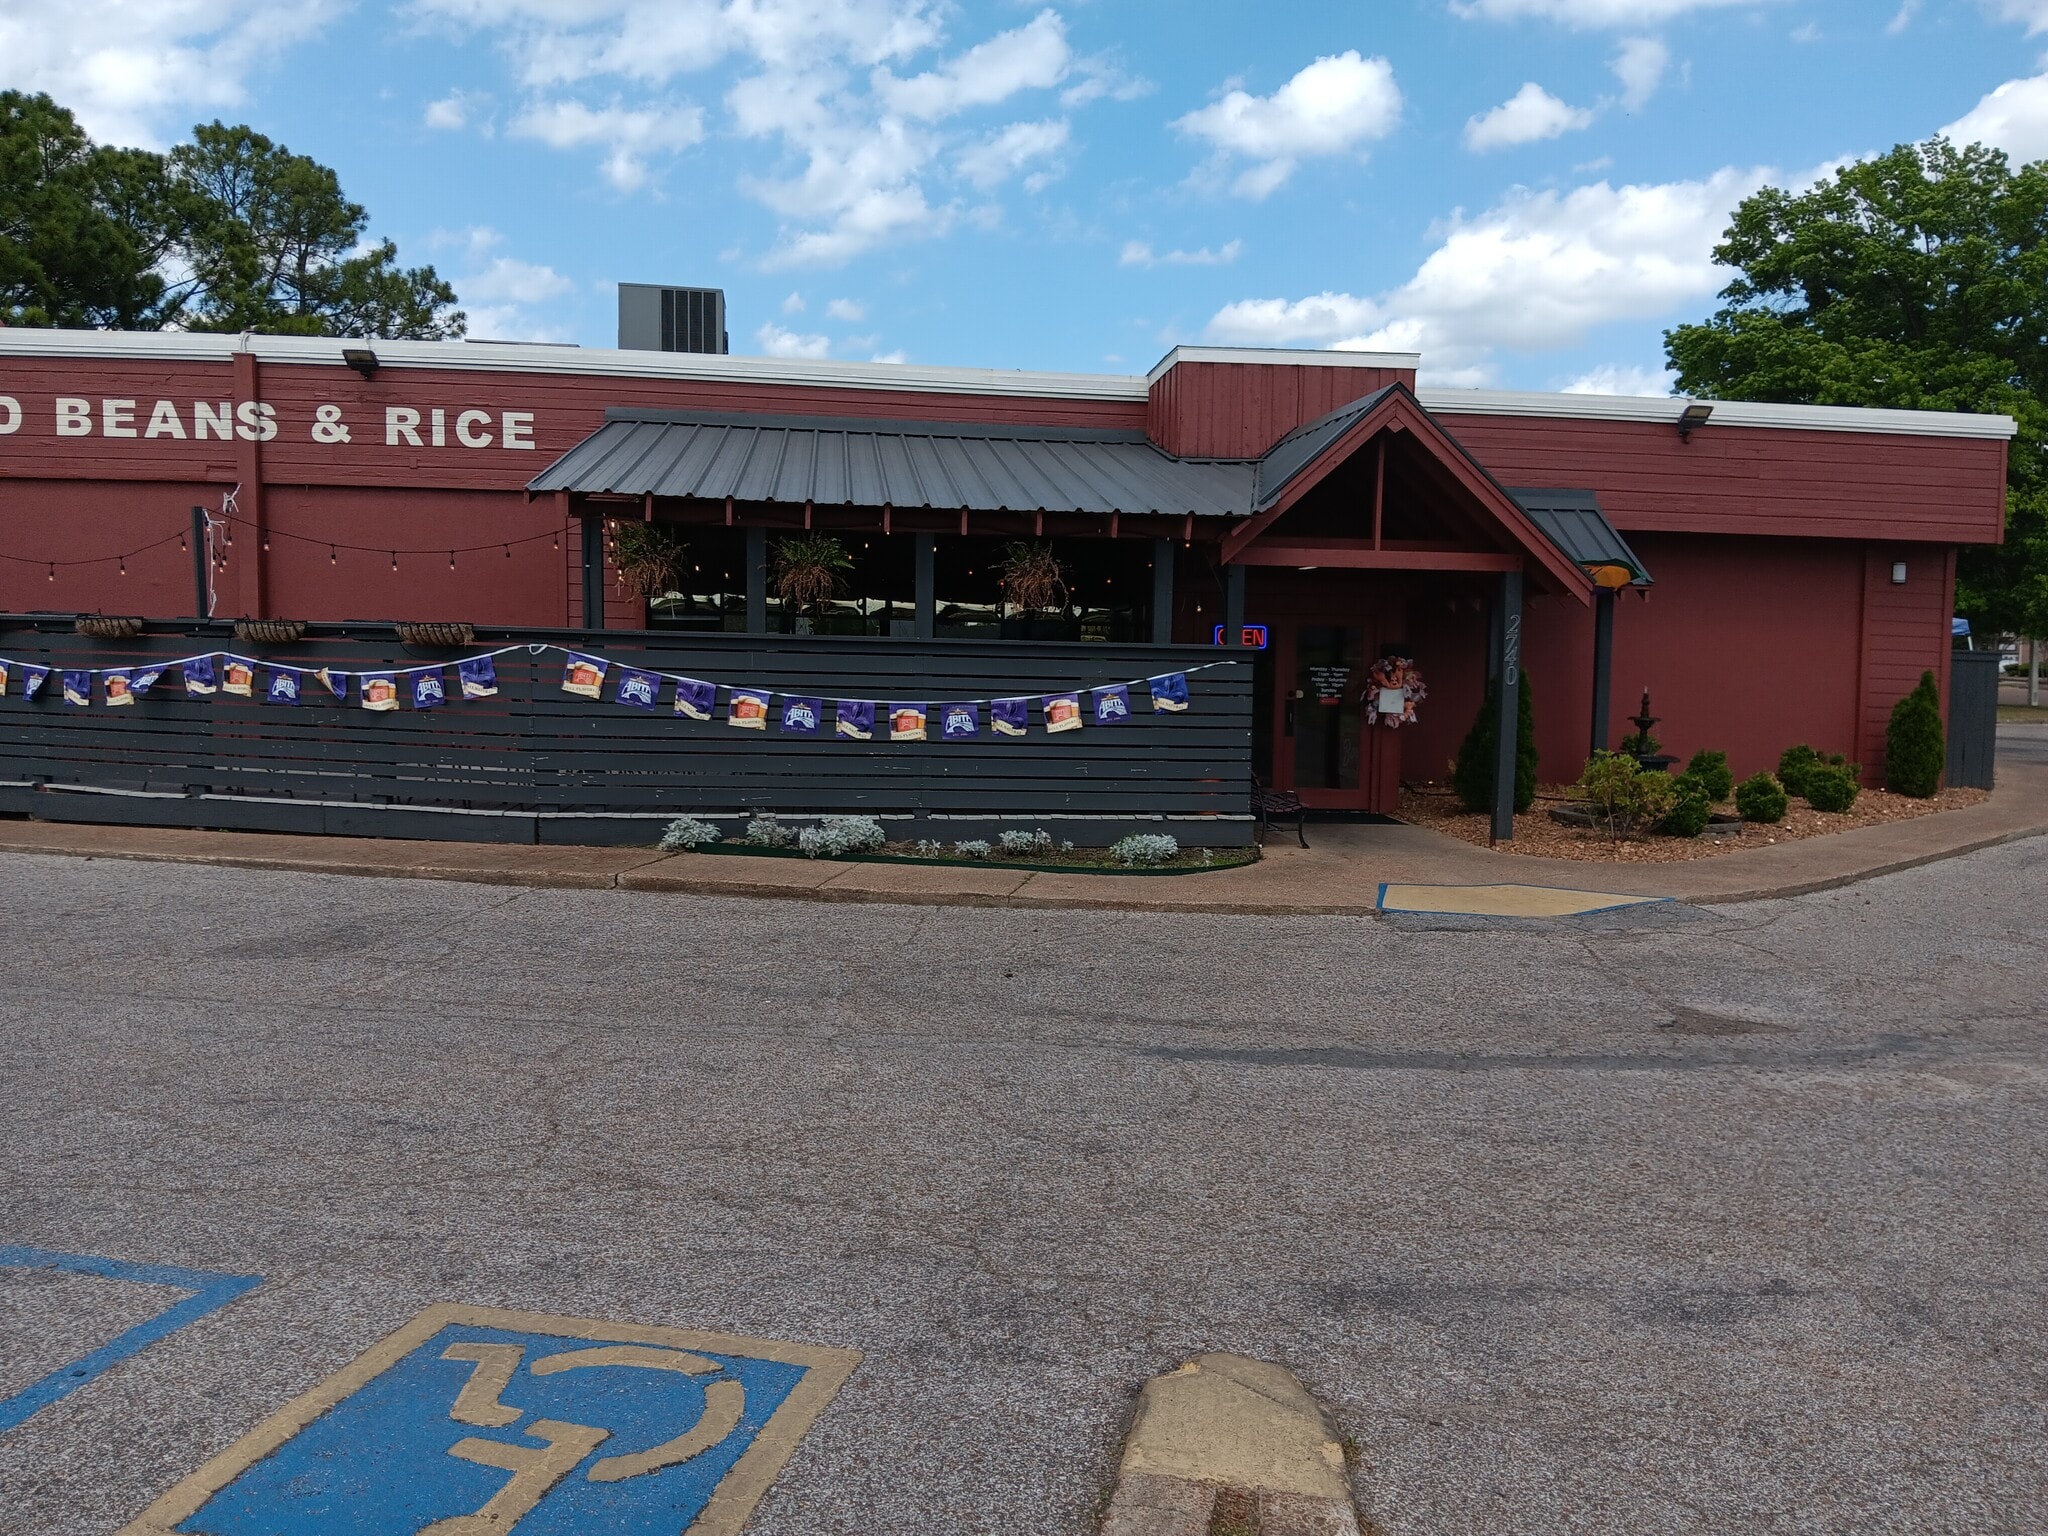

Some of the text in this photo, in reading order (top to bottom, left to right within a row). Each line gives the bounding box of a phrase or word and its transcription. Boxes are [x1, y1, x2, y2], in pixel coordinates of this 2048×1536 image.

[55, 397, 278, 441] BEANS
[311, 404, 351, 444] &
[385, 406, 535, 450] RICE
